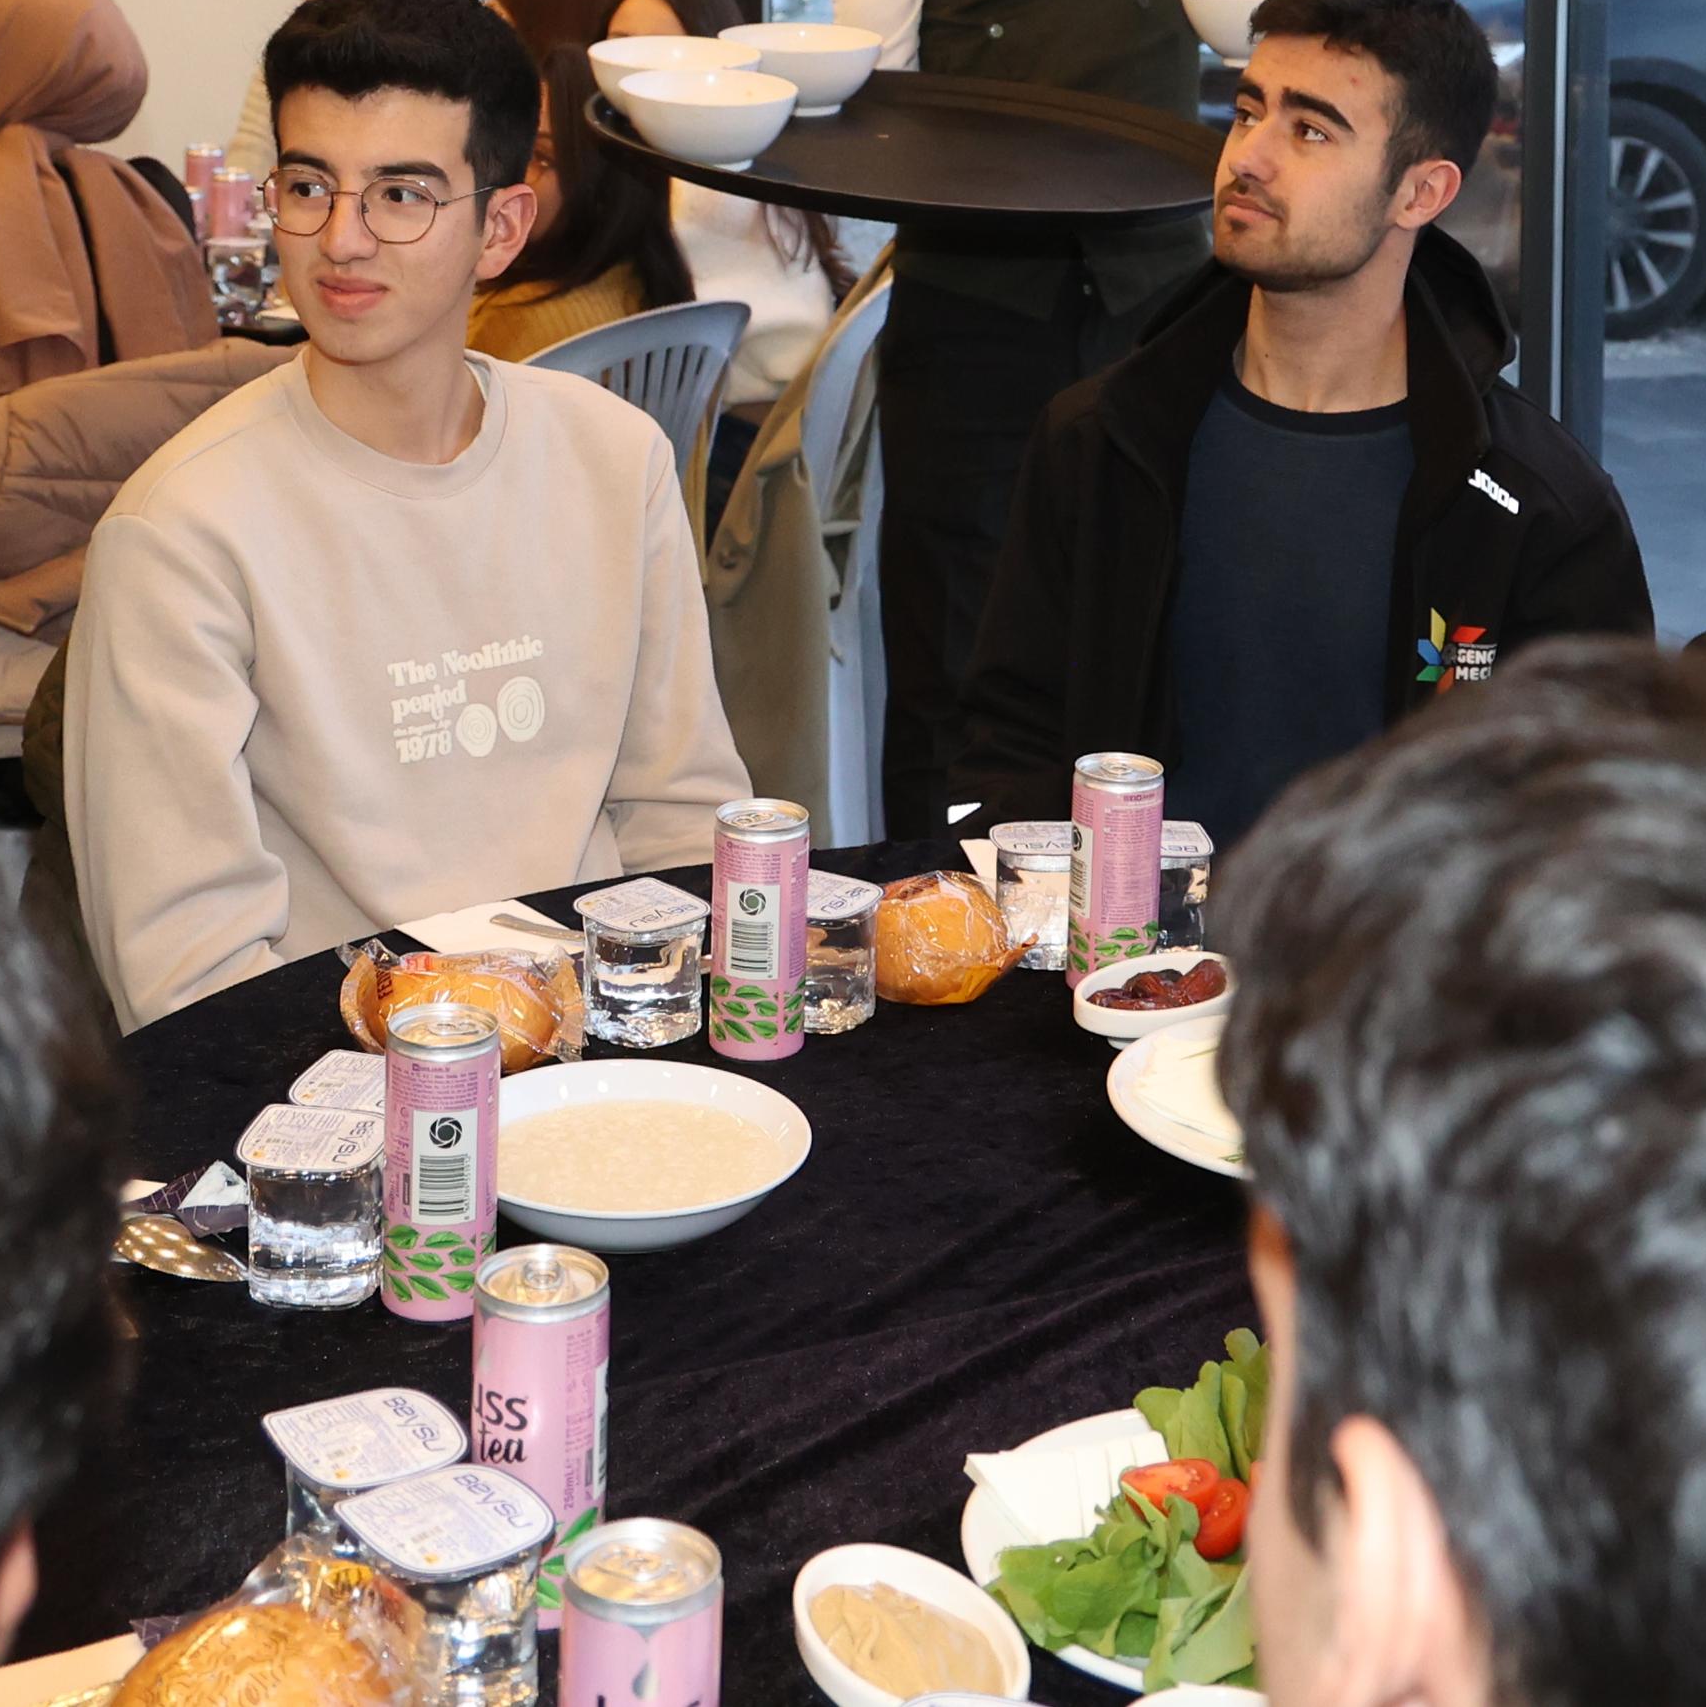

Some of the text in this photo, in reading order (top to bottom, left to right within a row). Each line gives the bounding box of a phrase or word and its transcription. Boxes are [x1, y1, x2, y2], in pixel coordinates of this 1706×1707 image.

[387, 635, 543, 686] The Neolithic
[478, 1422, 528, 1464] tea
